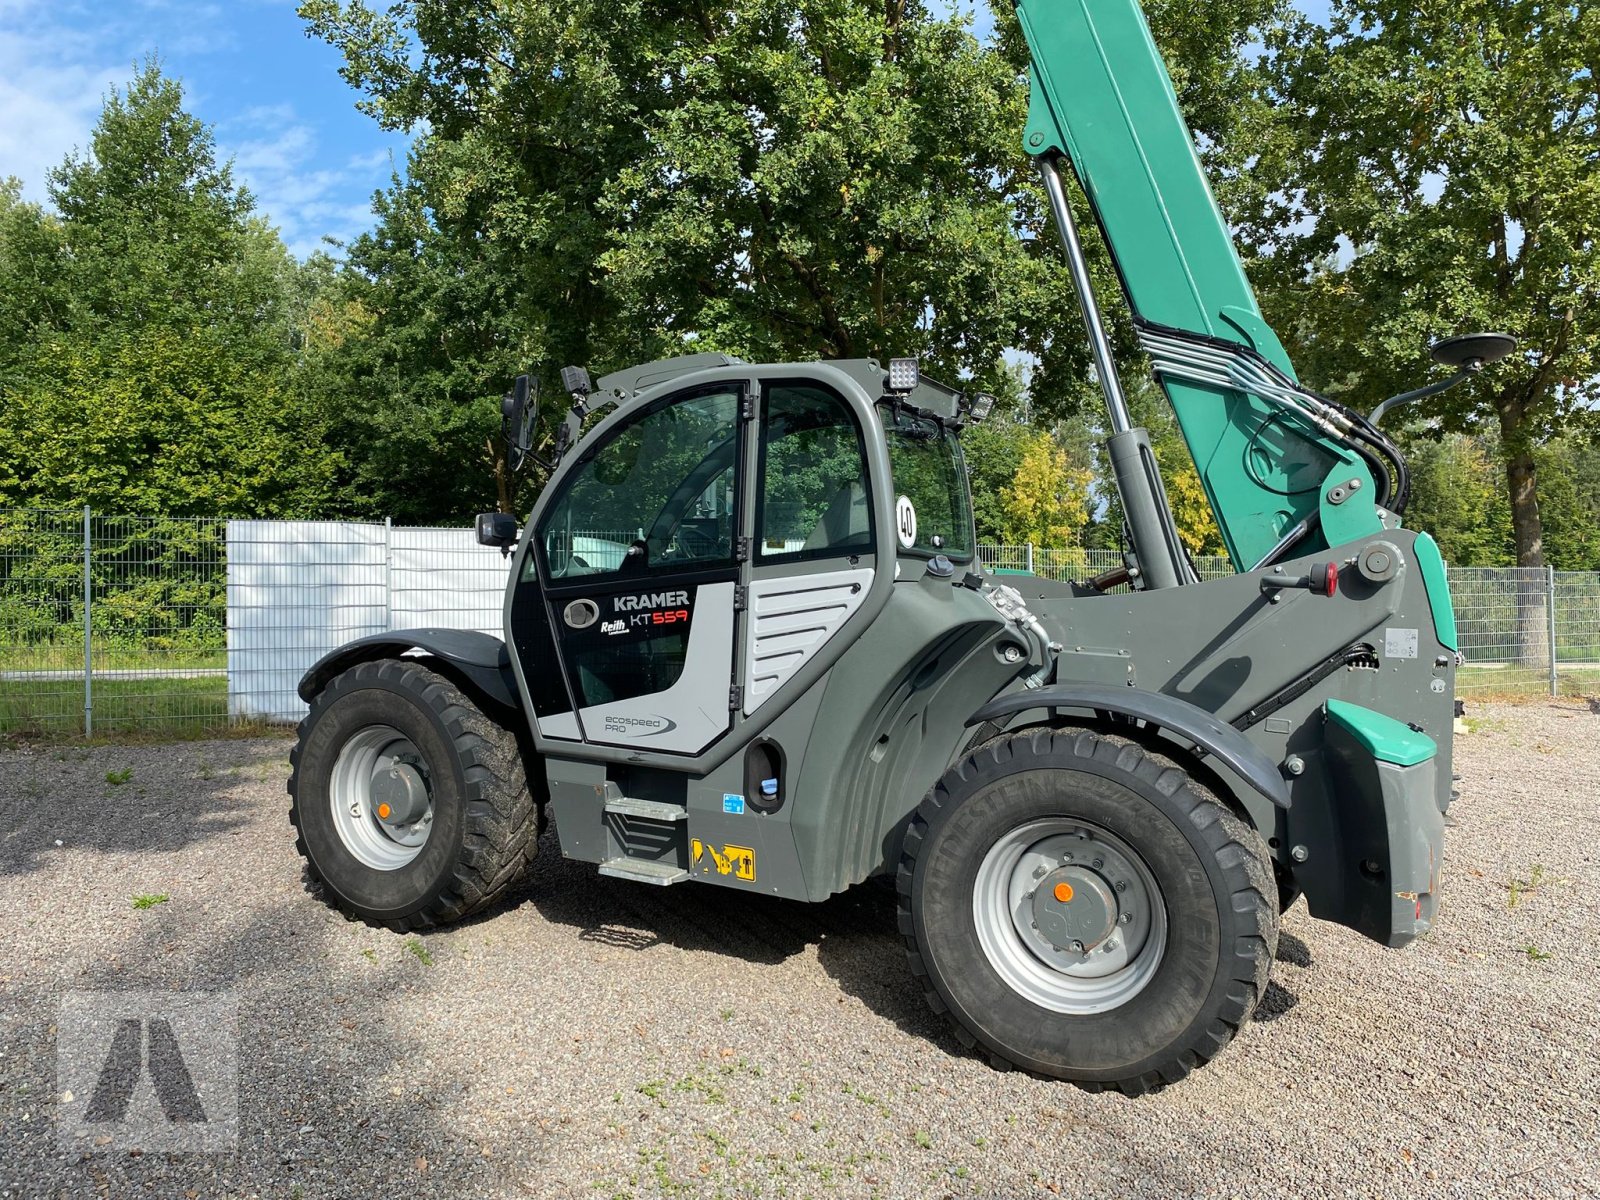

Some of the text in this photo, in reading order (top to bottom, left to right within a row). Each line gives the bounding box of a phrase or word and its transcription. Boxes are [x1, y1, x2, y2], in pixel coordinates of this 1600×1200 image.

[900, 505, 913, 538] 40
[613, 590, 690, 612] KRAMER
[600, 619, 626, 633] Reith
[605, 716, 660, 728] ecospeed
[605, 724, 627, 733] PRO
